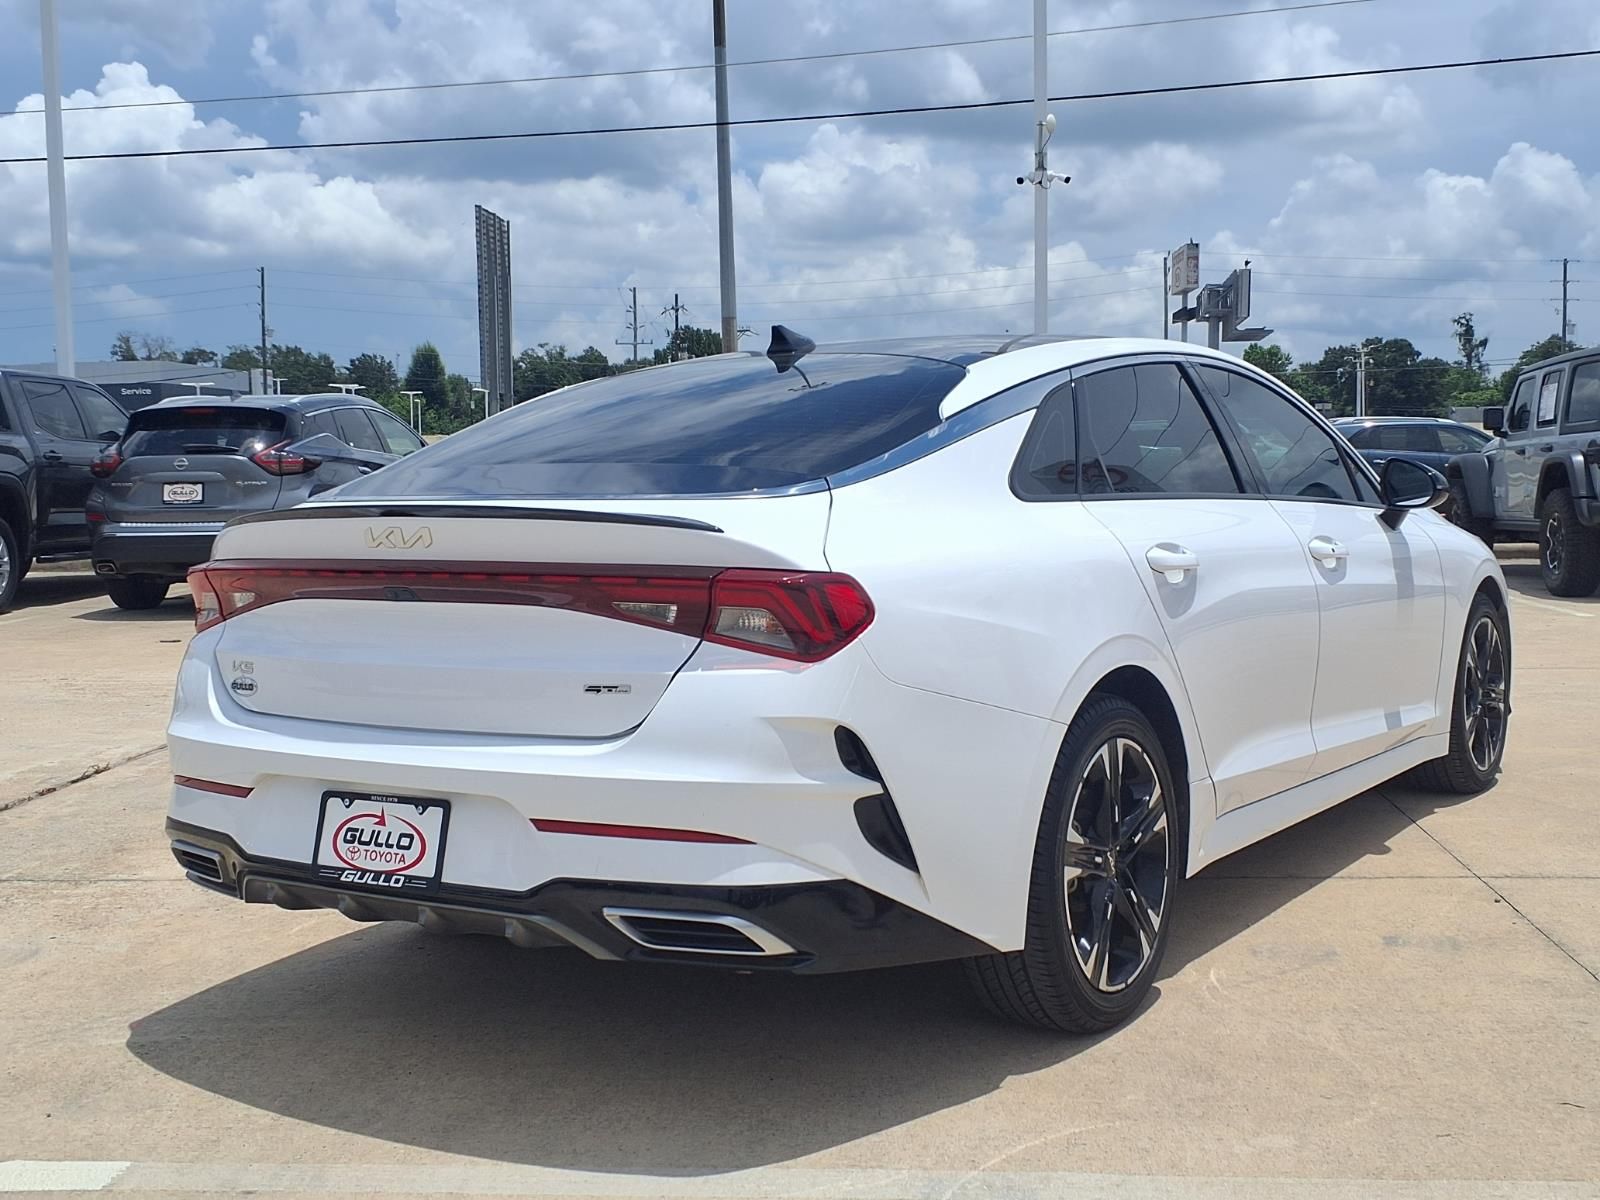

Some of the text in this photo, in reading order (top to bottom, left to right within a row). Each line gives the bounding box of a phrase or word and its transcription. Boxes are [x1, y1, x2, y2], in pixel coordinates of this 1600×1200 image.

[121, 387, 152, 395] Service
[364, 526, 433, 549] KIA
[231, 660, 255, 674] K5
[231, 682, 254, 691] GULLO
[342, 827, 415, 851] GULLO
[363, 849, 406, 865] TOYOTA
[340, 870, 405, 888] GULLO
